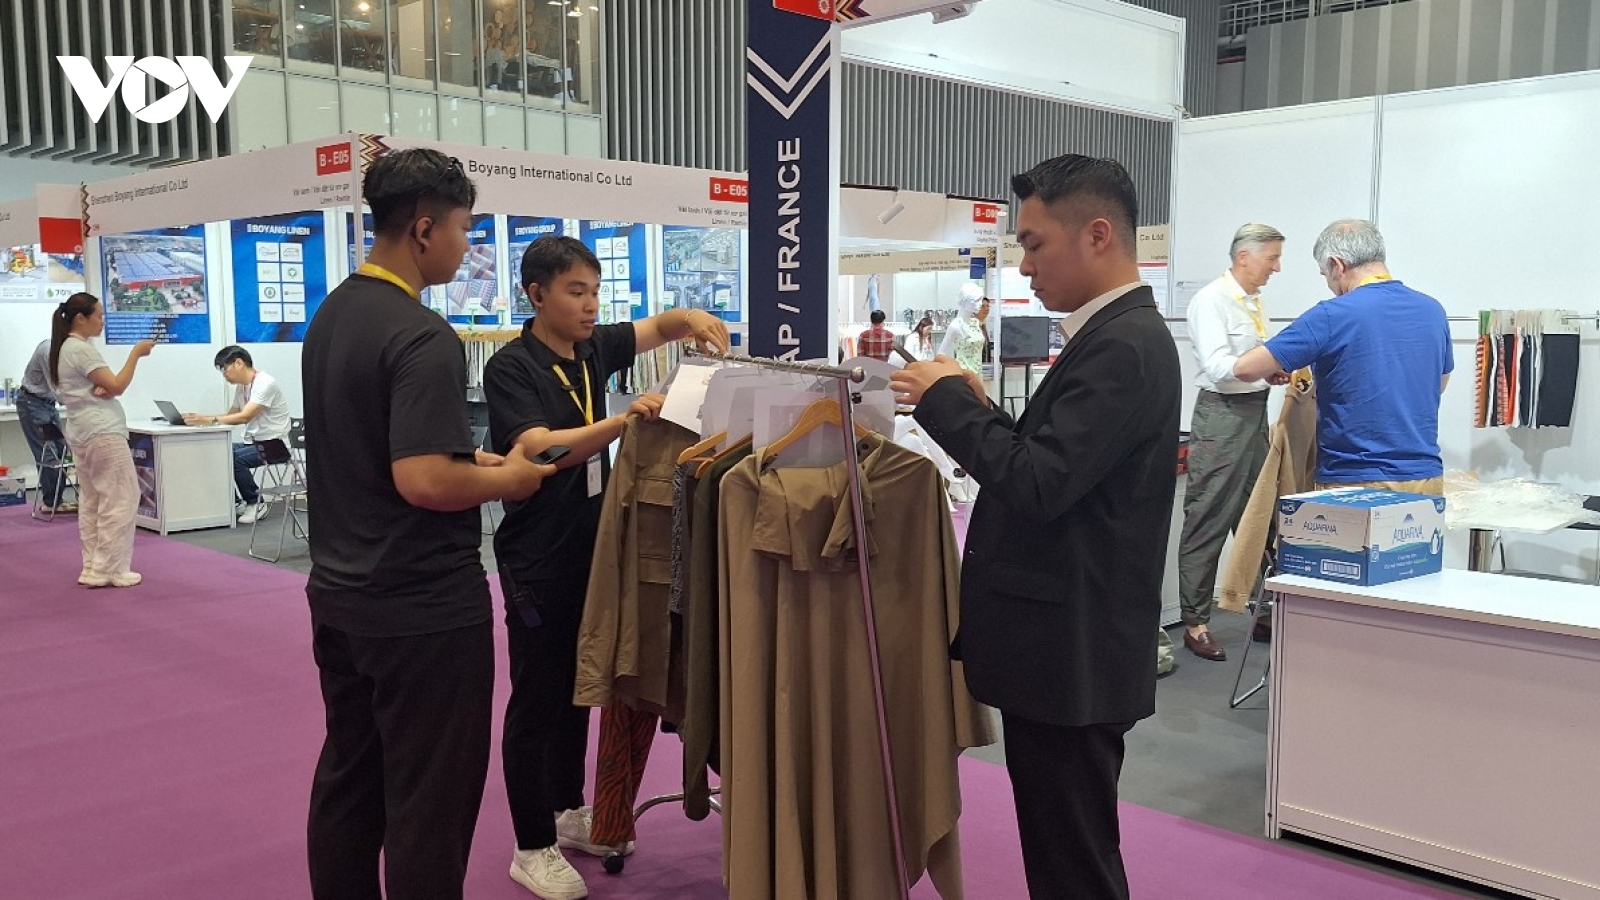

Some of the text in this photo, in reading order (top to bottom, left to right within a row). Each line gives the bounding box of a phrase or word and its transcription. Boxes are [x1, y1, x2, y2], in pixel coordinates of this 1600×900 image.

[320, 153, 327, 167] B
[333, 149, 349, 165] E05
[468, 160, 633, 186] Boyang International Co Ltd
[114, 190, 134, 203] Boyang
[134, 181, 168, 199] International
[168, 180, 178, 191] Co
[178, 177, 189, 190] Ltd
[713, 183, 722, 194] B
[729, 184, 748, 197] E05
[777, 137, 800, 292] FRANCE
[251, 223, 310, 236] BOYANG LINEN
[1140, 234, 1150, 242] Co
[1303, 521, 1339, 536] AQUAFINA
